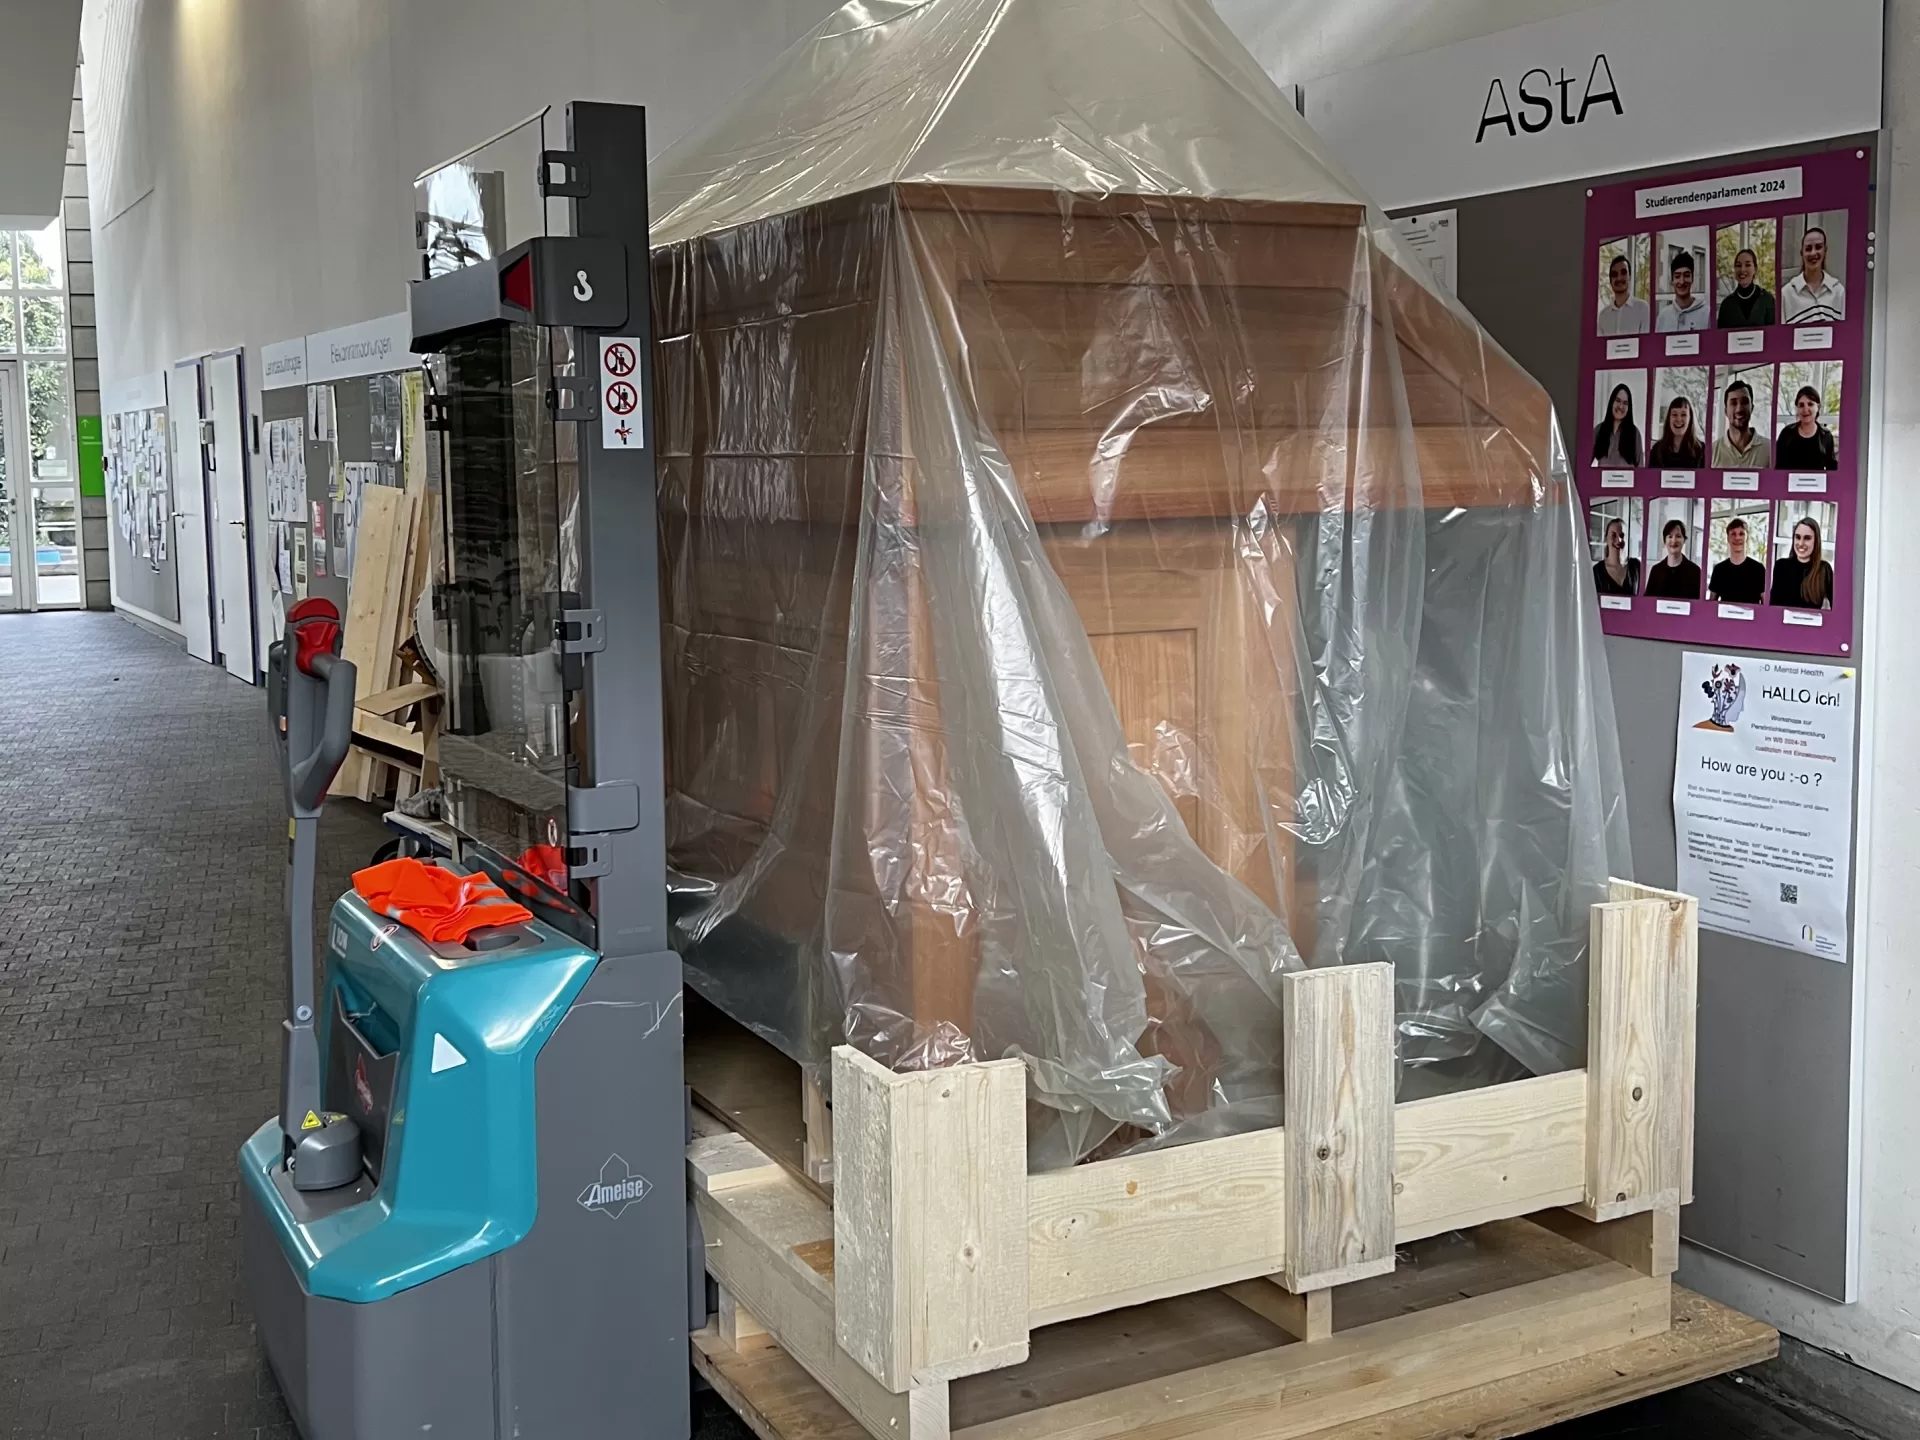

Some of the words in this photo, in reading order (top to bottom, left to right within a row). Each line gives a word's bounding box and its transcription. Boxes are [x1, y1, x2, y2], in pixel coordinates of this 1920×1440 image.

[1475, 53, 1623, 143] AStA
[1645, 183, 1757, 209] Studierendenparlament
[1759, 179, 1786, 194] 2024
[1773, 665, 1799, 675] Mental
[1800, 668, 1825, 677] Health
[1762, 685, 1811, 703] HALLO
[1770, 715, 1802, 725] Workshops
[1701, 756, 1732, 773] How
[1735, 764, 1757, 777] are
[1761, 768, 1785, 781] you
[1790, 772, 1809, 785] :-o
[1813, 772, 1823, 787] ?
[583, 1179, 644, 1207] Ameise
